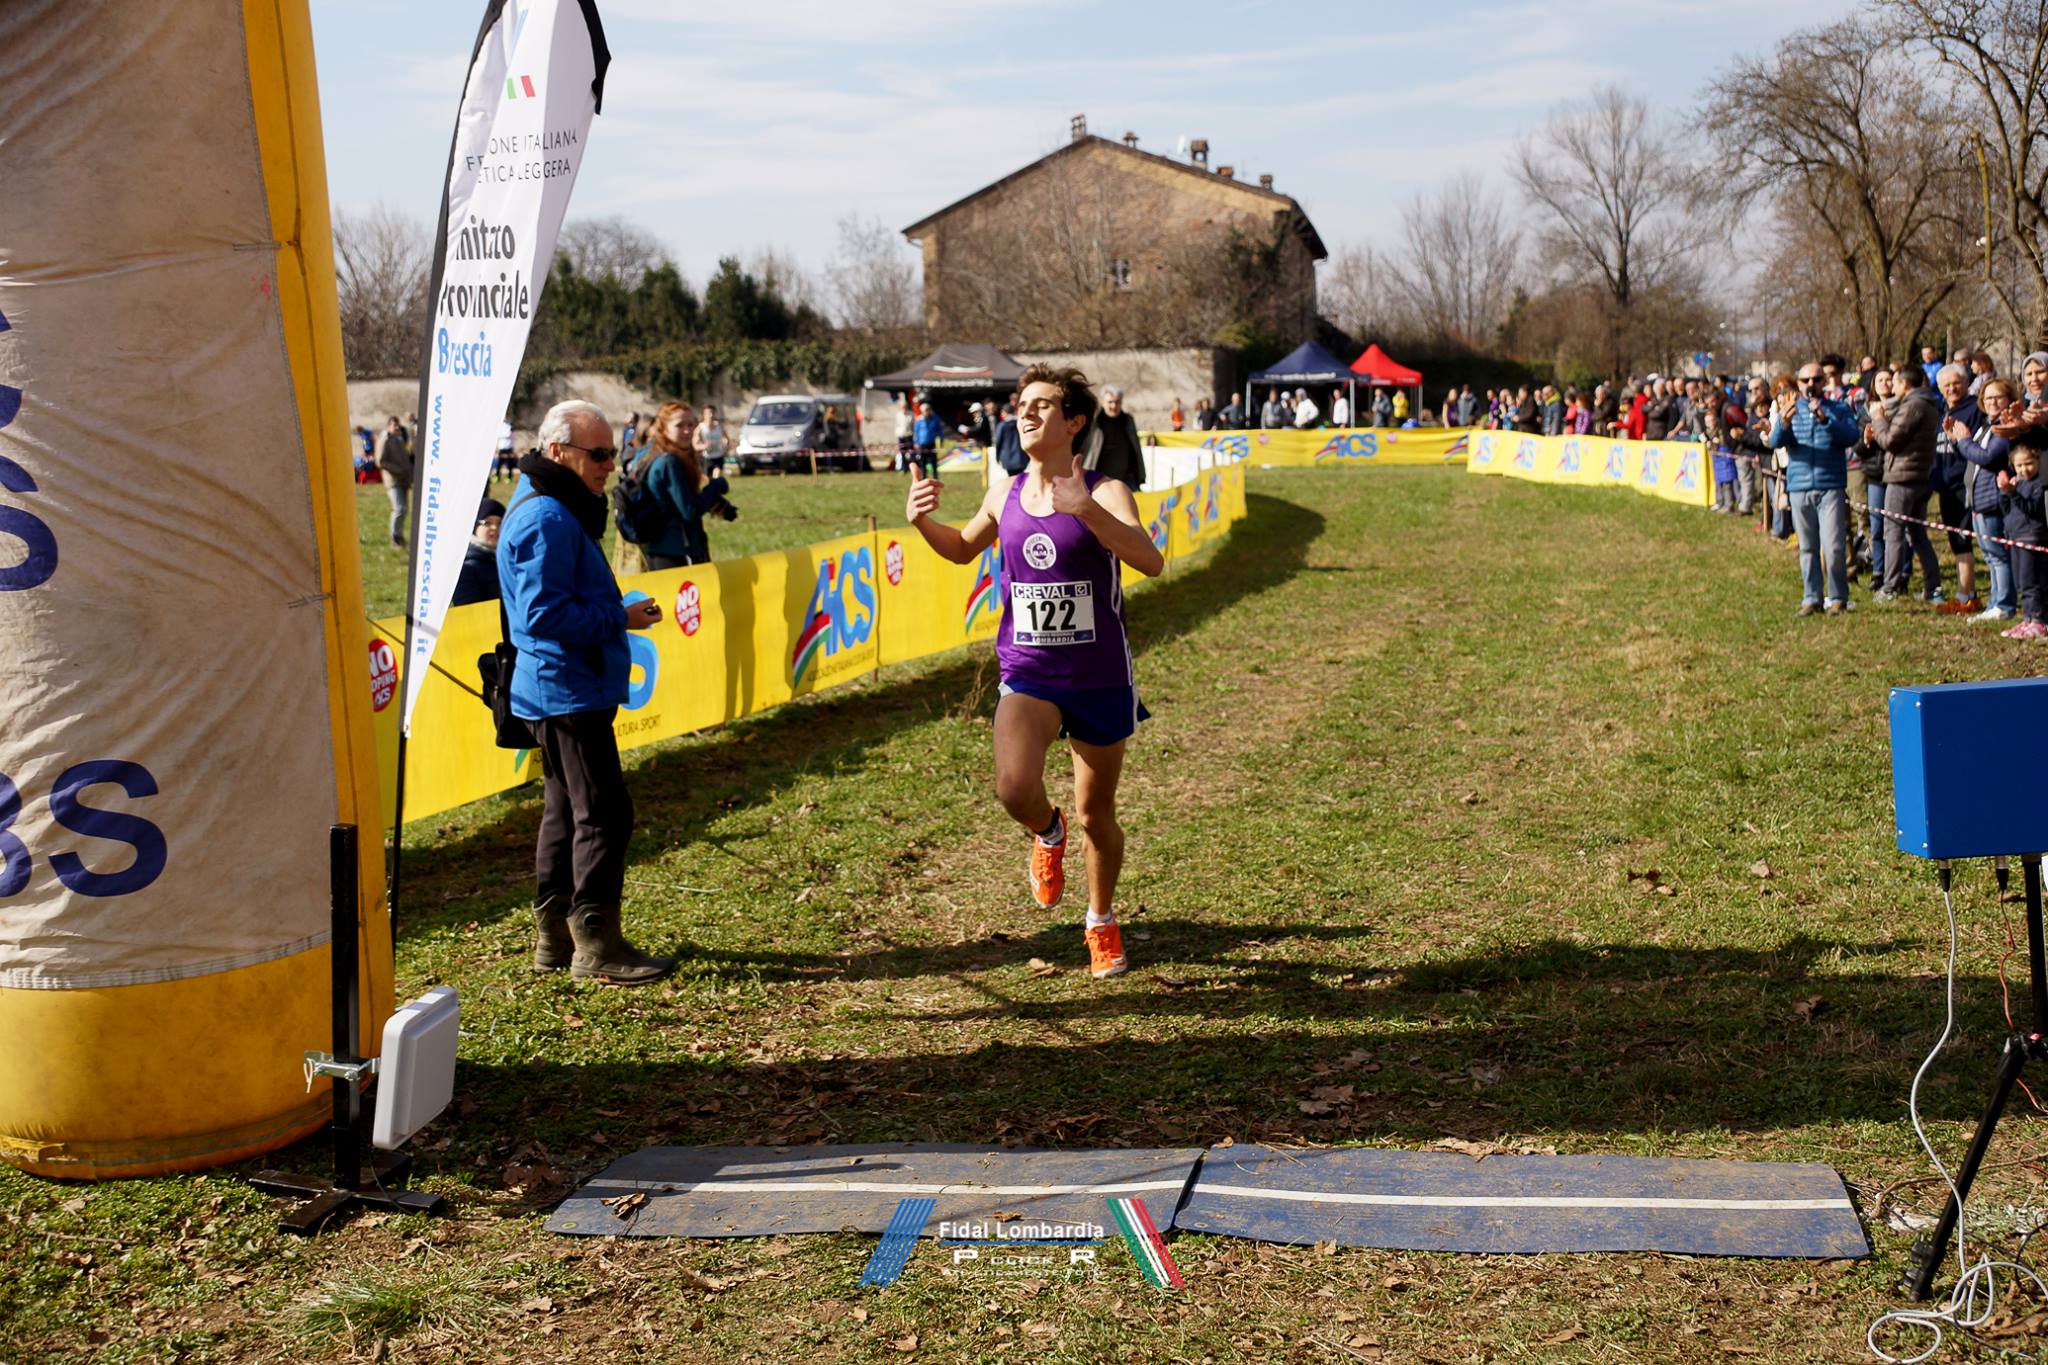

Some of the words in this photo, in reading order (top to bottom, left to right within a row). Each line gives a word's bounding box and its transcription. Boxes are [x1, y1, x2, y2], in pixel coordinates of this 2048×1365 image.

[438, 328, 492, 377] Brescia
[676, 585, 699, 613] NO
[1015, 585, 1070, 598] CREVAL
[1027, 600, 1077, 631] 122
